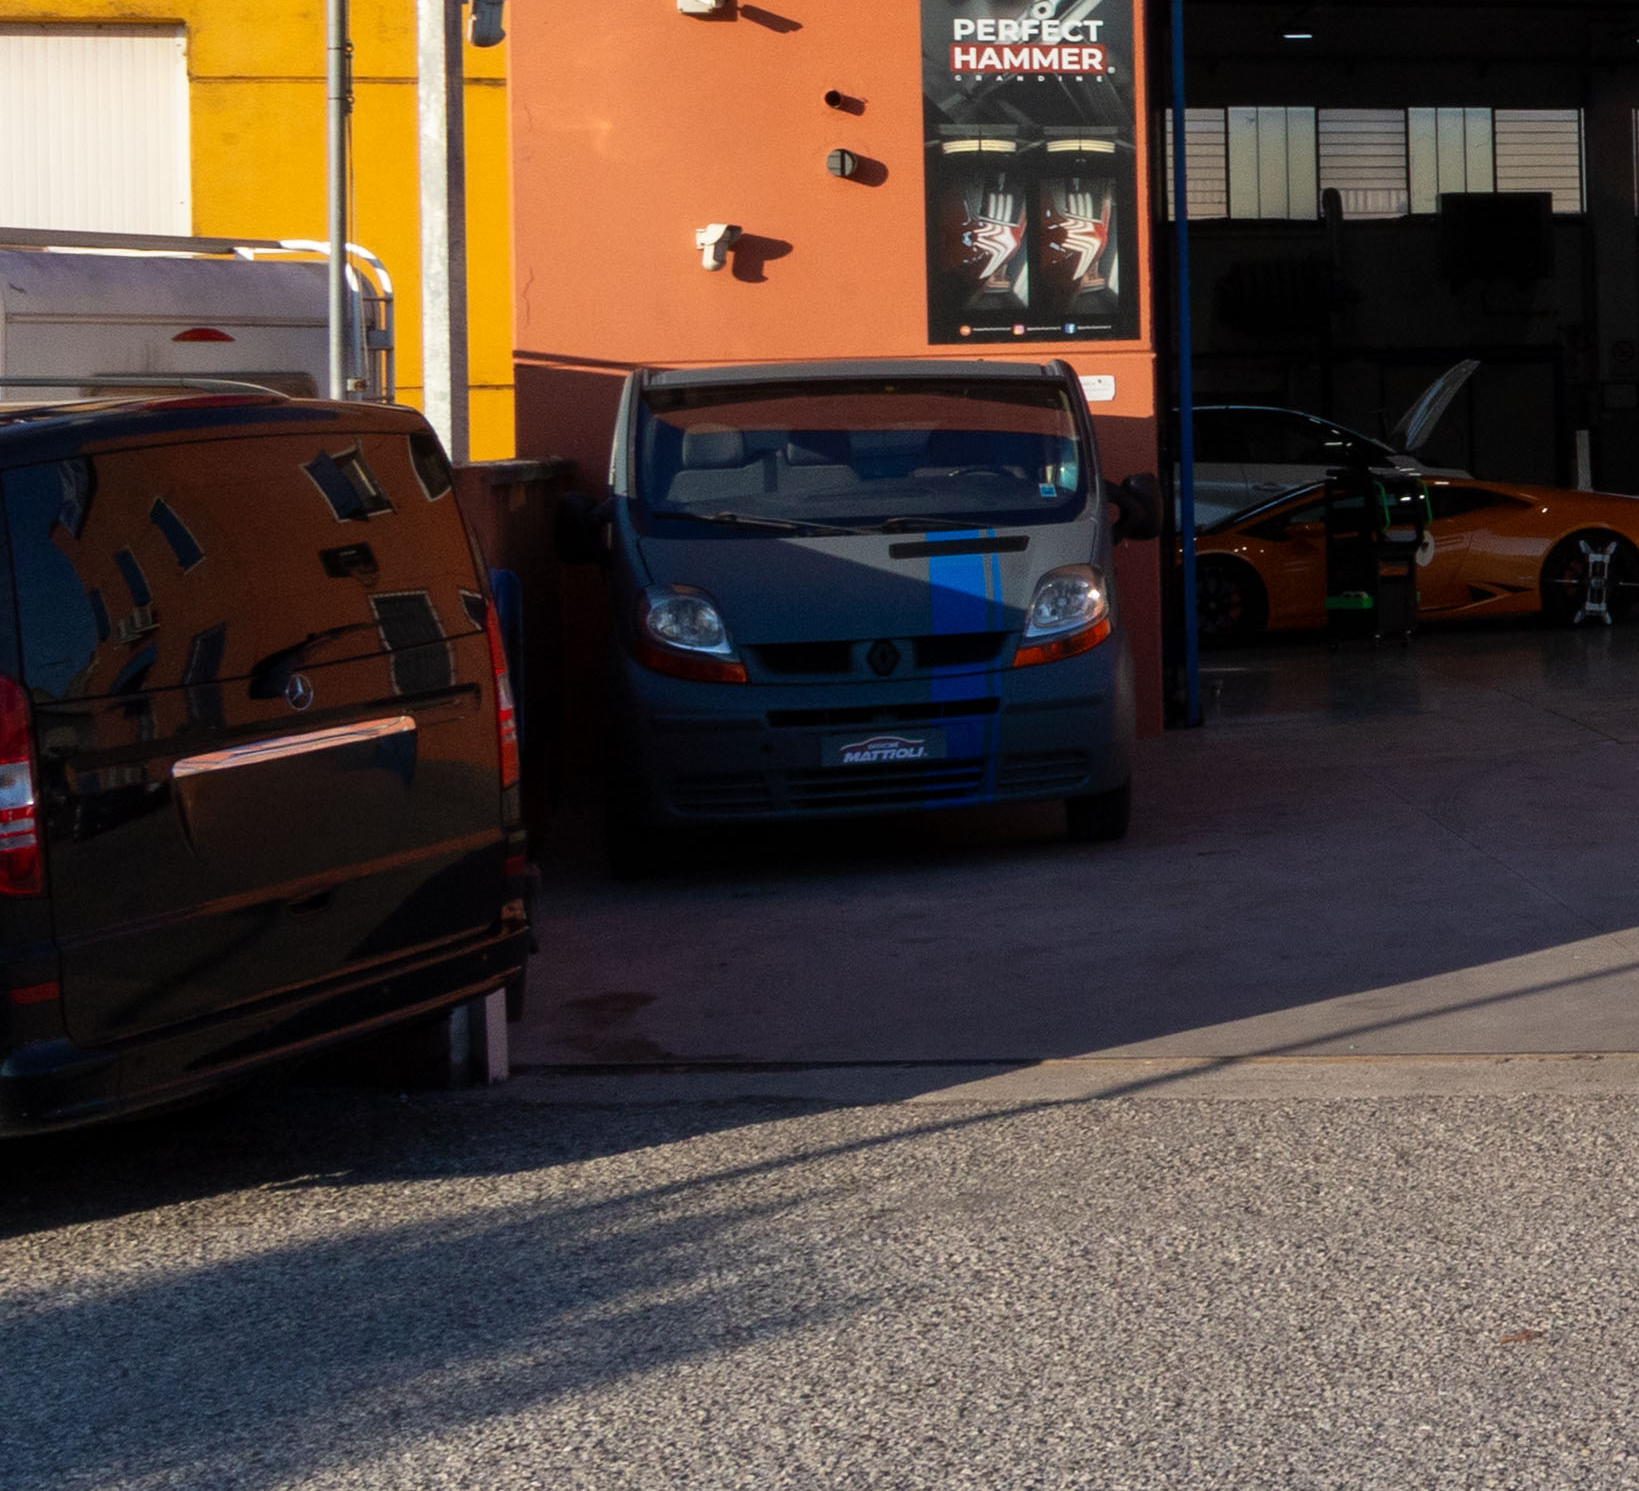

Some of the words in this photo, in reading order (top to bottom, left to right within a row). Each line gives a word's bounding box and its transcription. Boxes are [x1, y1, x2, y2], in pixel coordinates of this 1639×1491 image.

[953, 18, 1104, 42] PERFECT
[953, 46, 1104, 71] HAMMER
[953, 73, 1104, 83] GRANDINE
[843, 746, 925, 764] MATTIOLI
